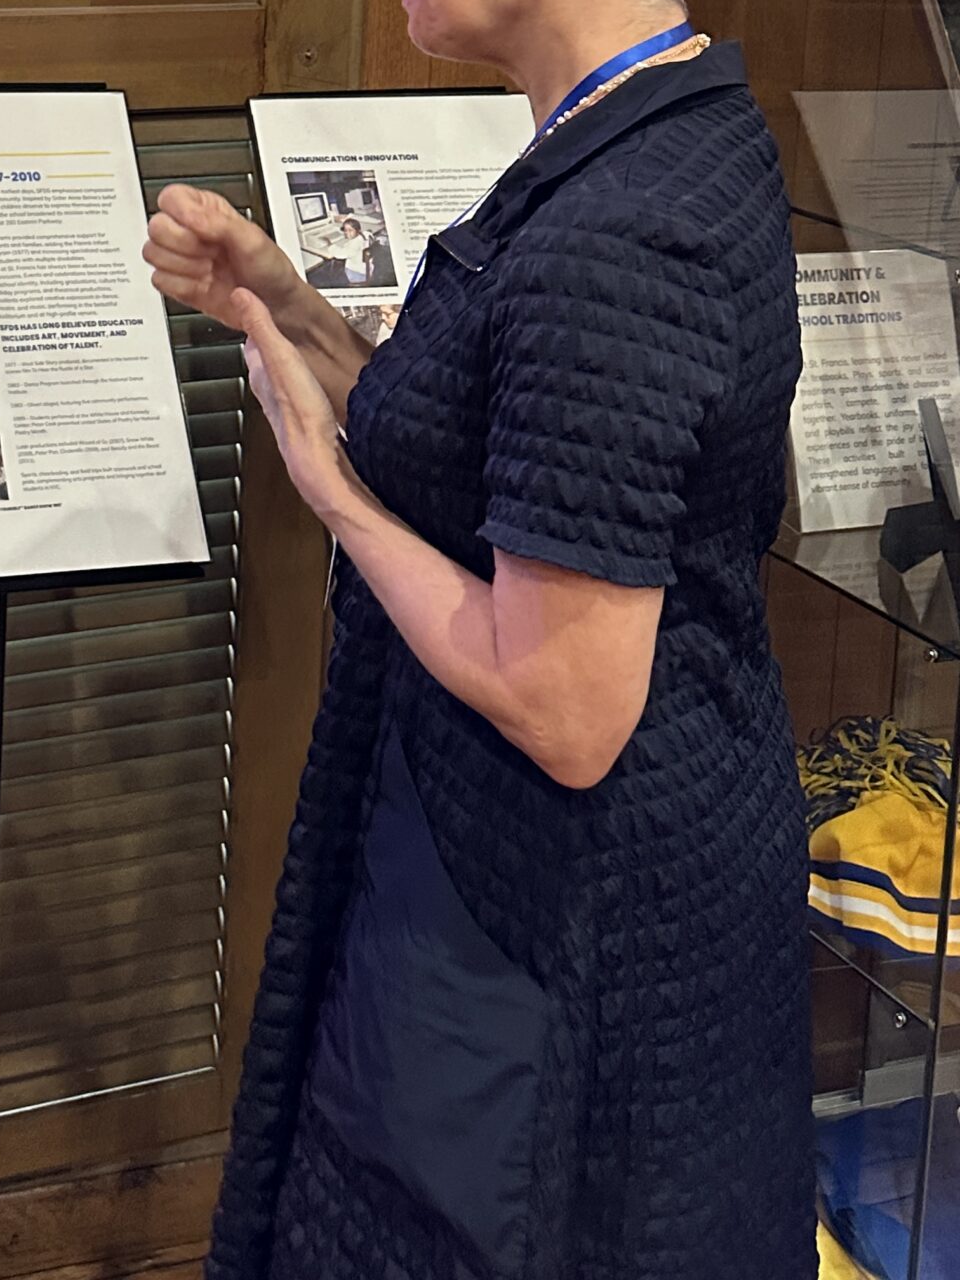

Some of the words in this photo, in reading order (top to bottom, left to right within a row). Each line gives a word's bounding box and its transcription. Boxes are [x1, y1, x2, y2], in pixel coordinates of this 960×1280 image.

[281, 154, 358, 164] COMMUNICATION
[364, 153, 419, 162] INNOVATION
[795, 267, 872, 283] OMMUNITY
[875, 267, 886, 280] &
[797, 290, 880, 307] ELEBRATION
[20, 323, 38, 331] HAS
[61, 320, 97, 329] BELIEVED
[98, 319, 144, 327] EDUCATION
[799, 315, 834, 326] HOOL
[835, 311, 903, 325] TRADITIONS
[1, 333, 40, 342] INCLUDES
[61, 331, 108, 339] MOVEMENT,
[109, 329, 127, 337] AND
[2, 343, 57, 353] CELEBRATION
[58, 342, 69, 350] OF
[70, 341, 102, 350] TALENT.
[851, 356, 882, 366] learning
[901, 354, 921, 363] never
[923, 351, 947, 361] limited
[908, 367, 922, 376] and
[926, 366, 949, 375] school
[840, 386, 858, 396] gave
[861, 382, 894, 392] students
[897, 381, 909, 389] the
[913, 380, 939, 389] chance
[942, 379, 950, 387] to
[892, 395, 907, 404] and
[804, 429, 820, 438] and
[859, 424, 882, 433] reflect
[886, 423, 899, 431] the
[902, 423, 914, 433] joy
[806, 441, 851, 452] experiences
[853, 439, 868, 448] and
[871, 438, 884, 446] the
[886, 436, 906, 446] pride
[908, 435, 916, 443] of
[843, 453, 876, 463] activities
[888, 449, 905, 459] built
[809, 468, 859, 480] strengthened
[902, 463, 916, 471] and
[839, 482, 860, 491] sense
[862, 480, 870, 489] of
